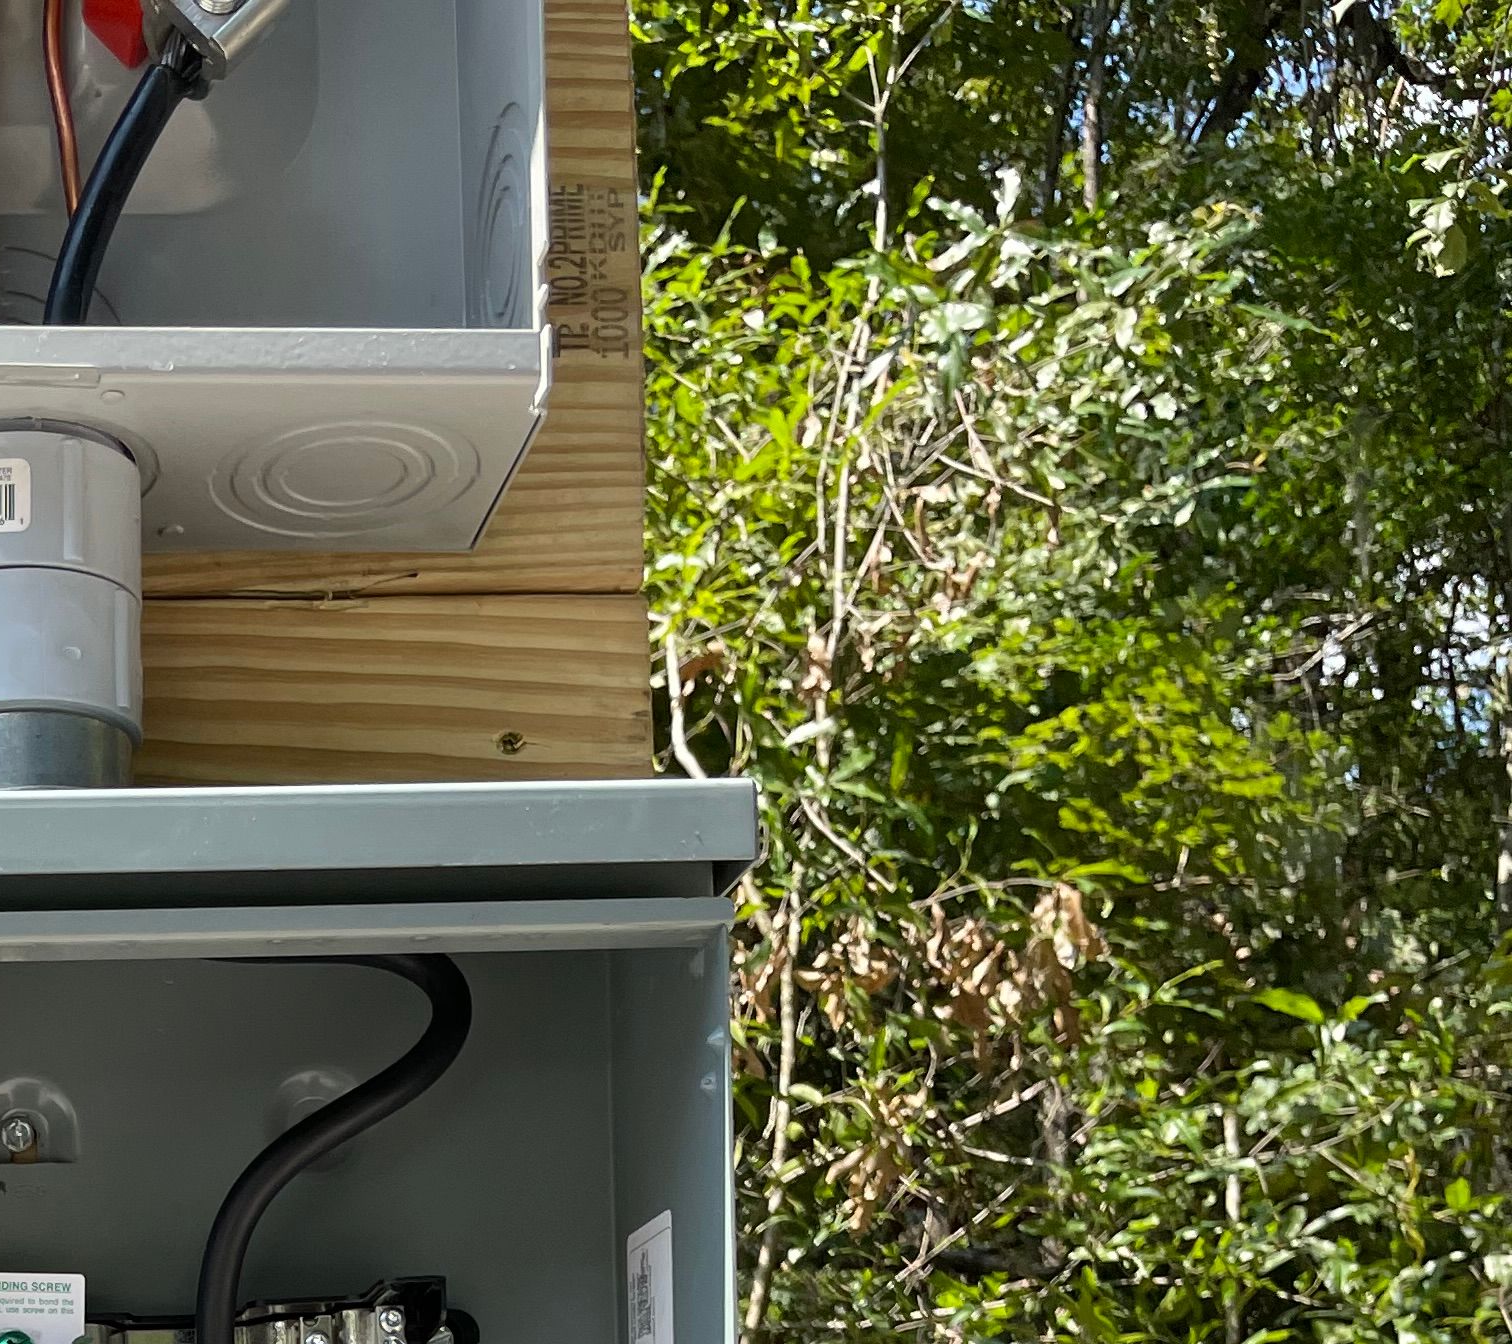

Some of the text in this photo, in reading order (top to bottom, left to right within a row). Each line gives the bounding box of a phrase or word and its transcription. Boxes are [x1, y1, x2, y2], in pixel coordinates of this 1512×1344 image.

[608, 187, 625, 252] SYP
[32, 1282, 72, 1292] SCREW
[39, 1297, 59, 1305] bond
